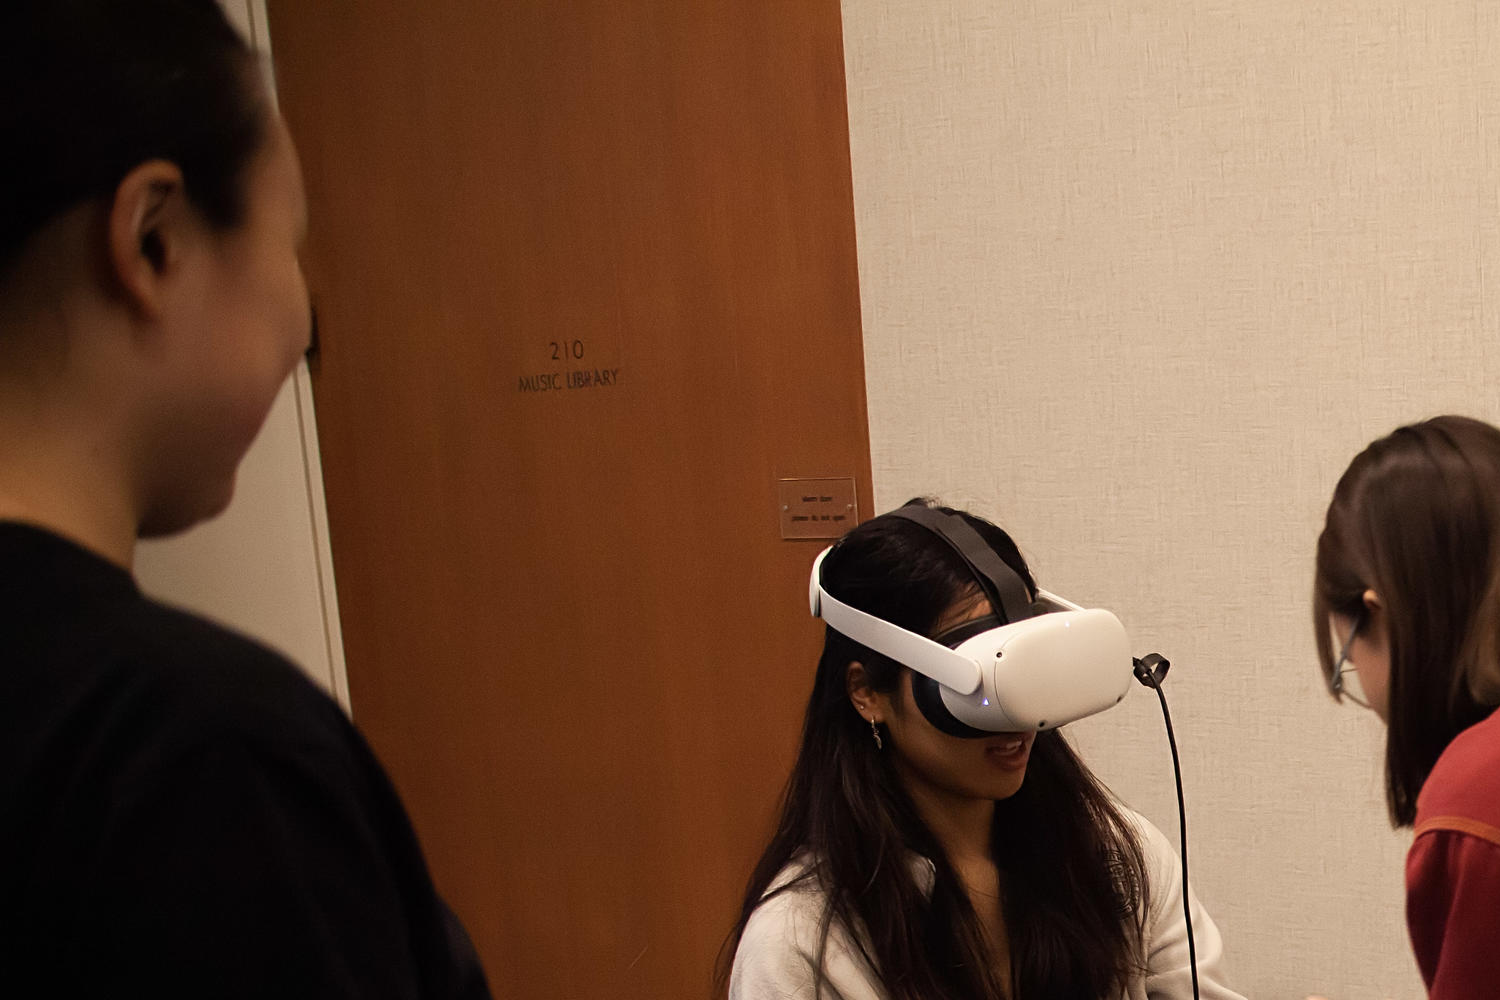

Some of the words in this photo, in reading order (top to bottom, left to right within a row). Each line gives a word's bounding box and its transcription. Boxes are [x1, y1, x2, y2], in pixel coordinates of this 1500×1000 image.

[549, 340, 584, 360] 210
[518, 373, 562, 393] MUSIC
[565, 368, 619, 389] LIBRARY
